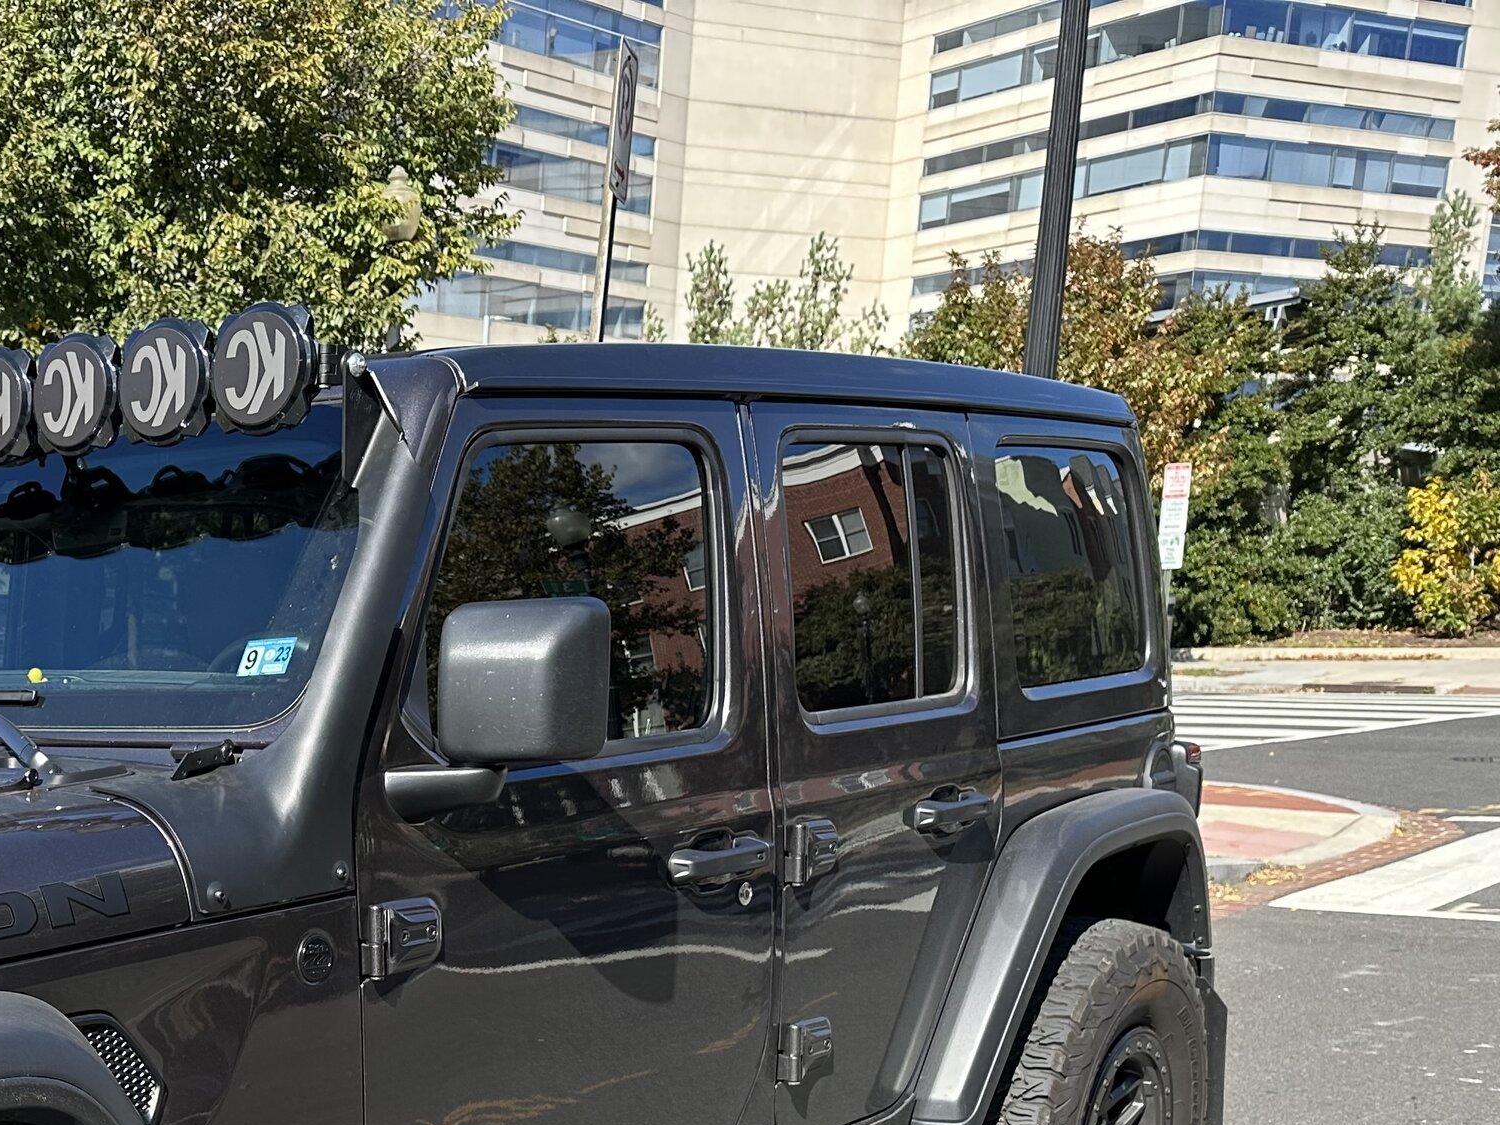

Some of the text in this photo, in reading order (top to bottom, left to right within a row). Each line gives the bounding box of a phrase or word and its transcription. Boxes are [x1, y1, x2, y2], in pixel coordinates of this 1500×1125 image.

[43, 351, 94, 438] KC
[131, 337, 186, 427] KC
[225, 321, 286, 414] KC
[245, 646, 291, 670] 9 23
